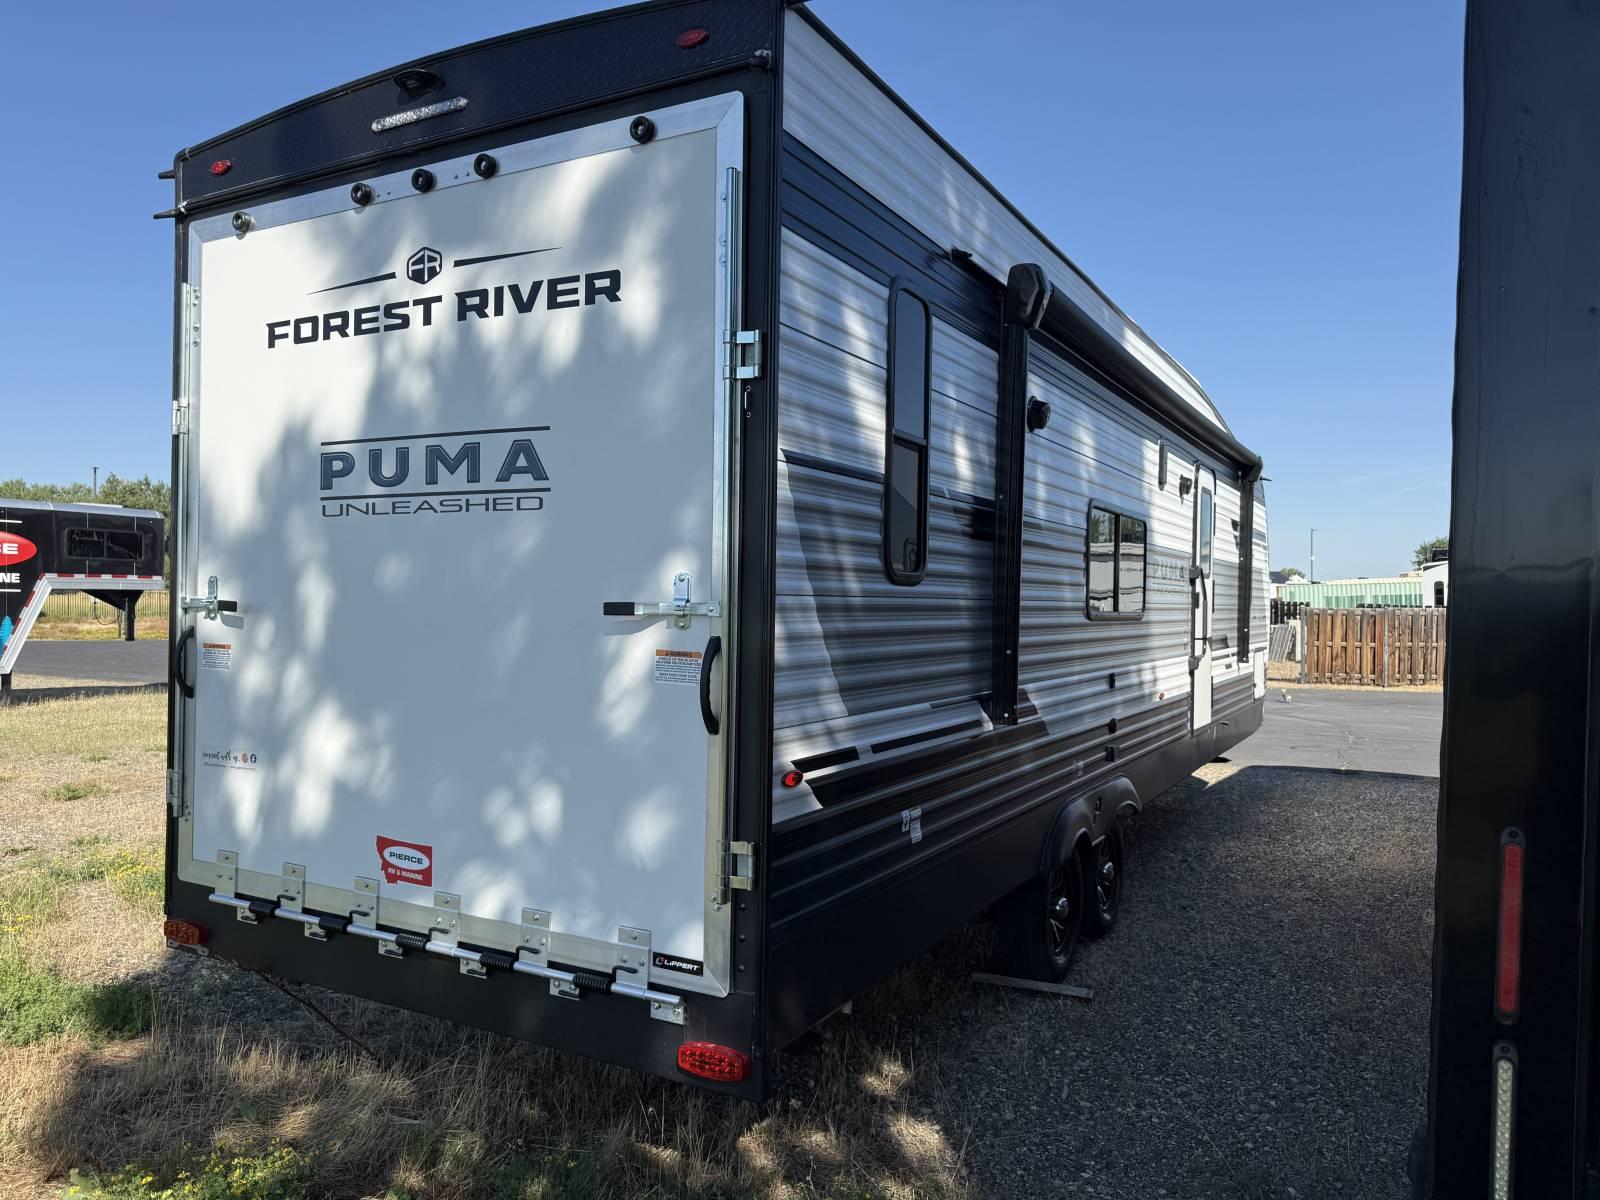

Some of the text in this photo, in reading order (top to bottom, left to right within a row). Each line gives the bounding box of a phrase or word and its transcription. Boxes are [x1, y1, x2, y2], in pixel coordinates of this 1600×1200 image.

[266, 269, 622, 349] FOREST RIVER
[320, 438, 550, 490] PUMA
[321, 496, 544, 517] UNLEASHED
[0, 543, 19, 555] E
[389, 851, 424, 865] PIERCE
[401, 870, 424, 881] MARINE
